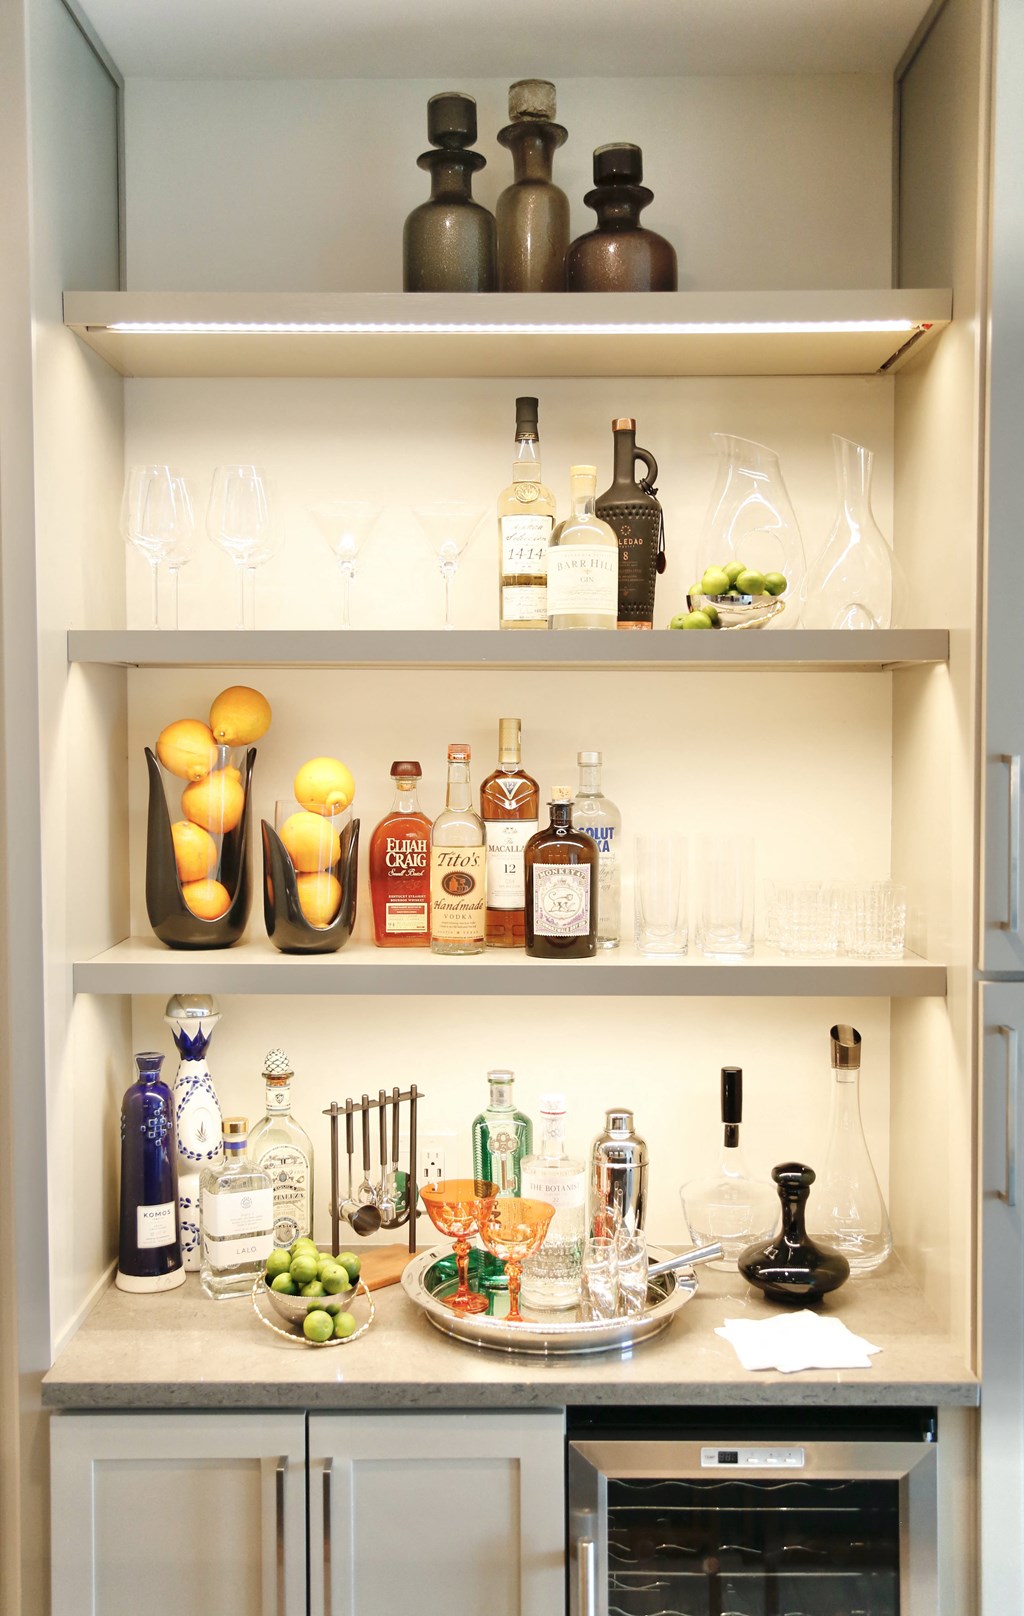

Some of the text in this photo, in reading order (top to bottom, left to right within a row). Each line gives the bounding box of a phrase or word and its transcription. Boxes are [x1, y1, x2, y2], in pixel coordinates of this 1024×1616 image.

[508, 548, 545, 560] 1414
[623, 551, 629, 561] 8
[557, 559, 586, 571] BARR
[386, 838, 427, 854] ELIJAH
[488, 845, 525, 853] MACALLA
[385, 852, 427, 869] CRAIG
[438, 851, 479, 867] Tito's
[504, 864, 516, 874] 12
[538, 868, 574, 879] MONKEY
[434, 898, 484, 911] Handmade
[530, 1183, 545, 1192] THE
[143, 1209, 171, 1218] KOMOS
[236, 1246, 257, 1255] LALO
